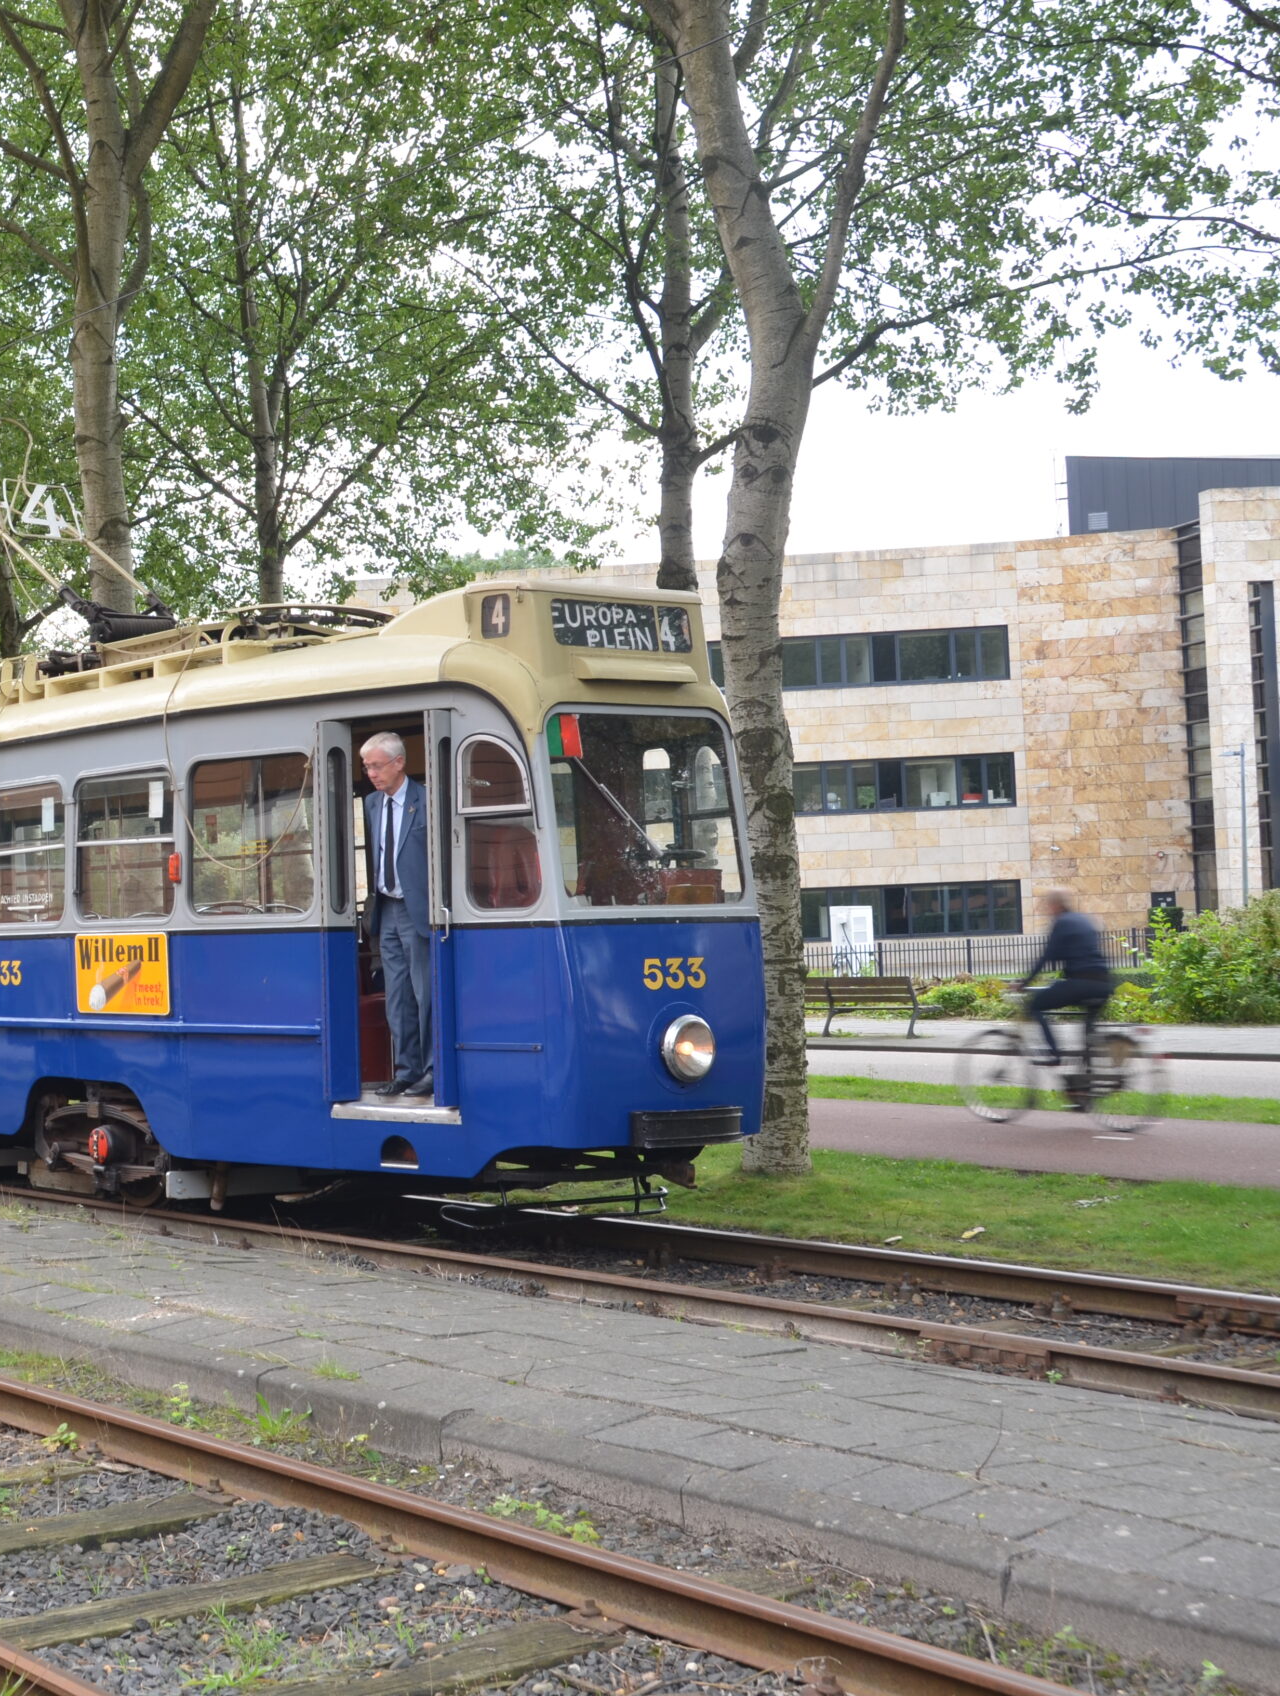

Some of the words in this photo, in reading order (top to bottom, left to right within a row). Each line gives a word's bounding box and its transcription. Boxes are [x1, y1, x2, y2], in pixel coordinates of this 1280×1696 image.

[21, 484, 68, 538] 4
[491, 596, 506, 634] 4
[586, 627, 655, 652] PLEIN
[660, 616, 676, 652] 4
[78, 938, 144, 970] Willem
[147, 937, 160, 962] II
[643, 957, 707, 990] 533
